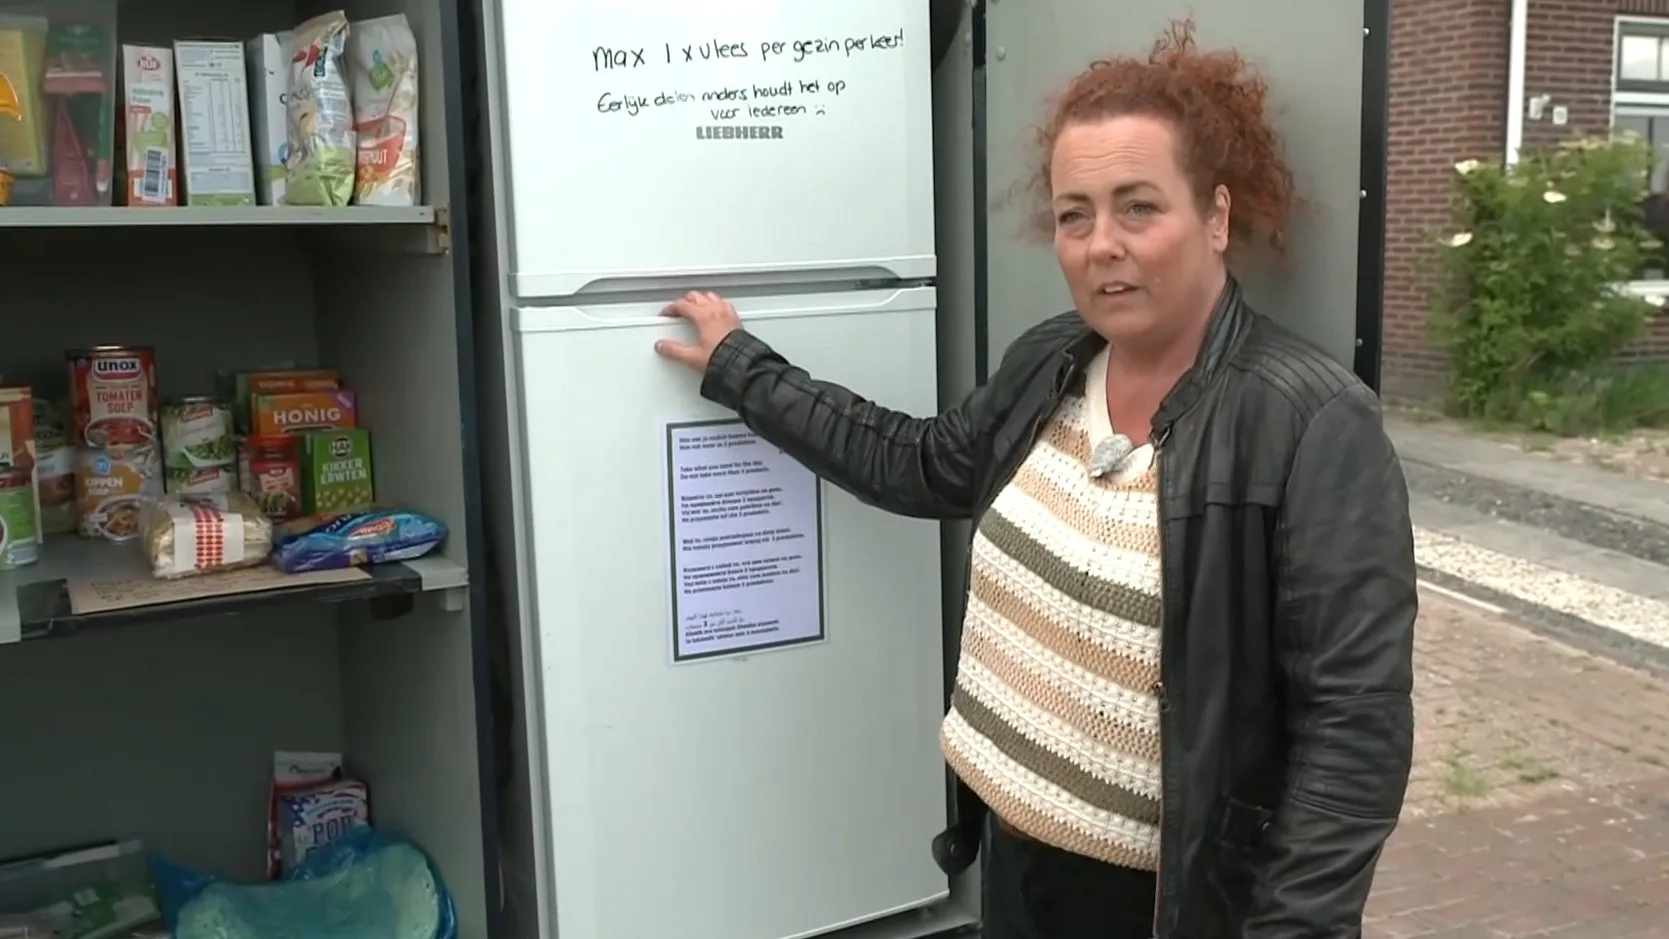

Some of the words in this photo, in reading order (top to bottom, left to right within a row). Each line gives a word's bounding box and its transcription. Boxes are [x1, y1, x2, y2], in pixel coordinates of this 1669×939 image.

[593, 46, 645, 71] Max
[761, 41, 786, 61] per
[793, 37, 840, 62] gezin
[844, 37, 868, 58] per
[753, 80, 792, 99] houdt
[799, 79, 820, 93] het
[827, 79, 846, 96] op
[748, 104, 806, 118] iedereen
[696, 126, 784, 140] LIEBHERR
[97, 360, 138, 371] unox
[96, 389, 142, 402] TOMATEN
[107, 401, 134, 414] SOEP
[273, 408, 341, 424] HONIG
